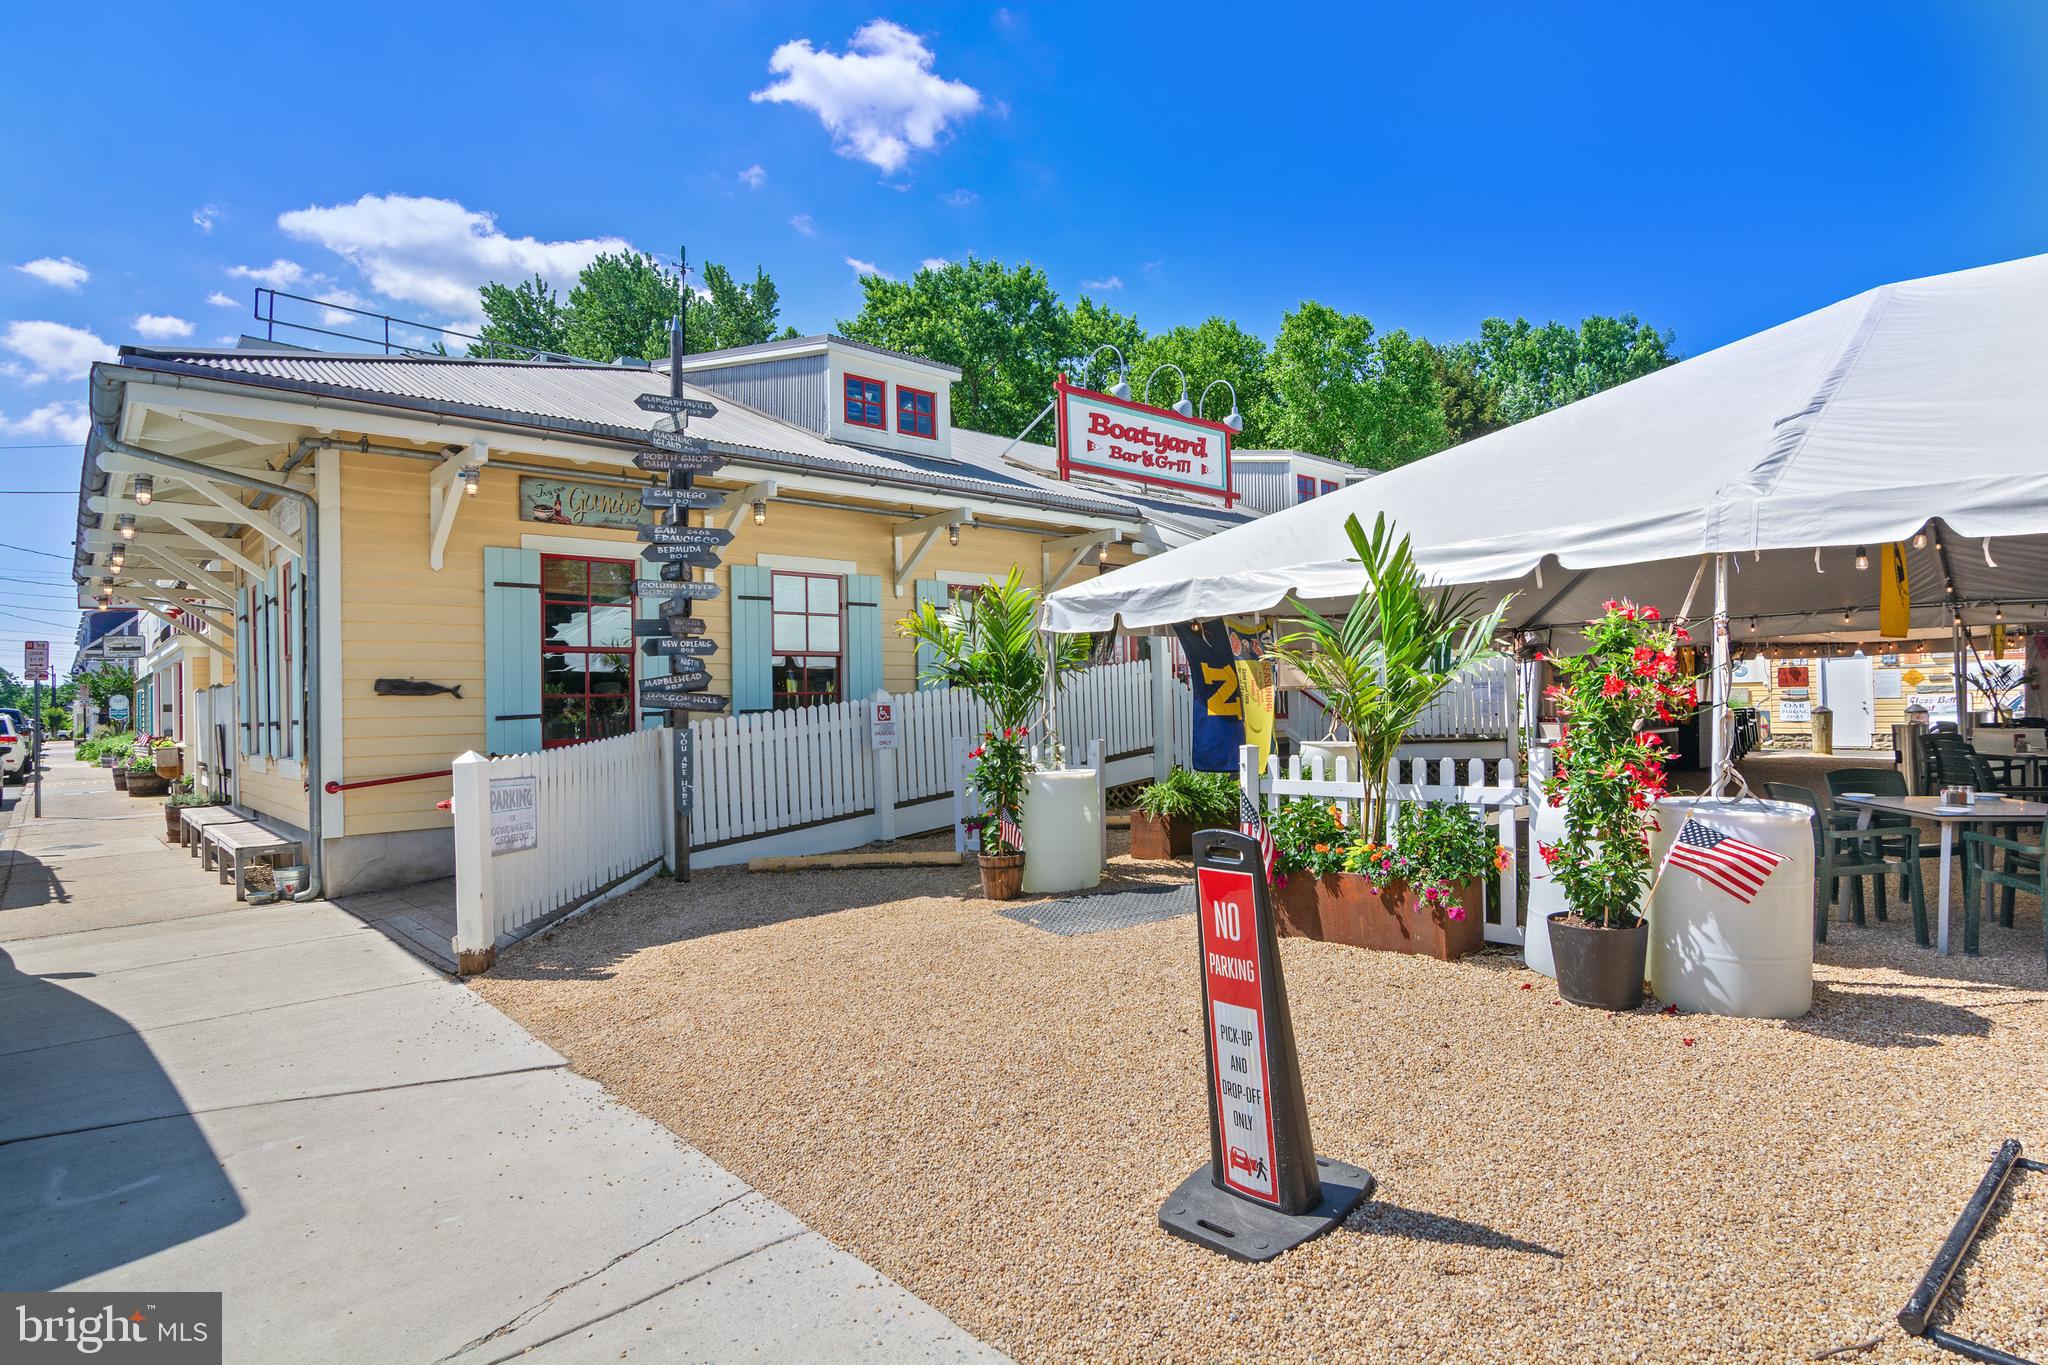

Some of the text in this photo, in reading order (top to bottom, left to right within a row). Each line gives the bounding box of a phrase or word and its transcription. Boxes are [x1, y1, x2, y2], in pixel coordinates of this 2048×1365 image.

[642, 395, 713, 410] MARGARITAVILLE
[652, 431, 693, 446] MACKINAC
[1088, 412, 1208, 458] Boatyard
[653, 439, 682, 449] ISLAND
[643, 453, 714, 464] NORTH SHORE
[536, 482, 553, 499] Try
[654, 490, 707, 500] SAN DIEGO
[569, 486, 641, 524] Gumbo
[654, 527, 677, 535] SAN
[654, 534, 720, 544] FRANCISCO
[657, 545, 701, 554] BERMUDA
[641, 582, 686, 590] COLUMBIA
[679, 640, 712, 648] ORLEANS
[680, 658, 699, 667] AUSTIN
[644, 672, 702, 687] MARBLEHEAD
[644, 692, 718, 704] JACKSON HOLE
[680, 732, 688, 751] YOU
[489, 787, 534, 812] PARKING
[1213, 899, 1241, 942] NO
[1209, 951, 1255, 983] PARKING
[1220, 1024, 1253, 1047] PICK-UP
[1230, 1055, 1248, 1074] AND
[1221, 1079, 1262, 1105] DROP-OFF
[1233, 1110, 1253, 1132] ONLY
